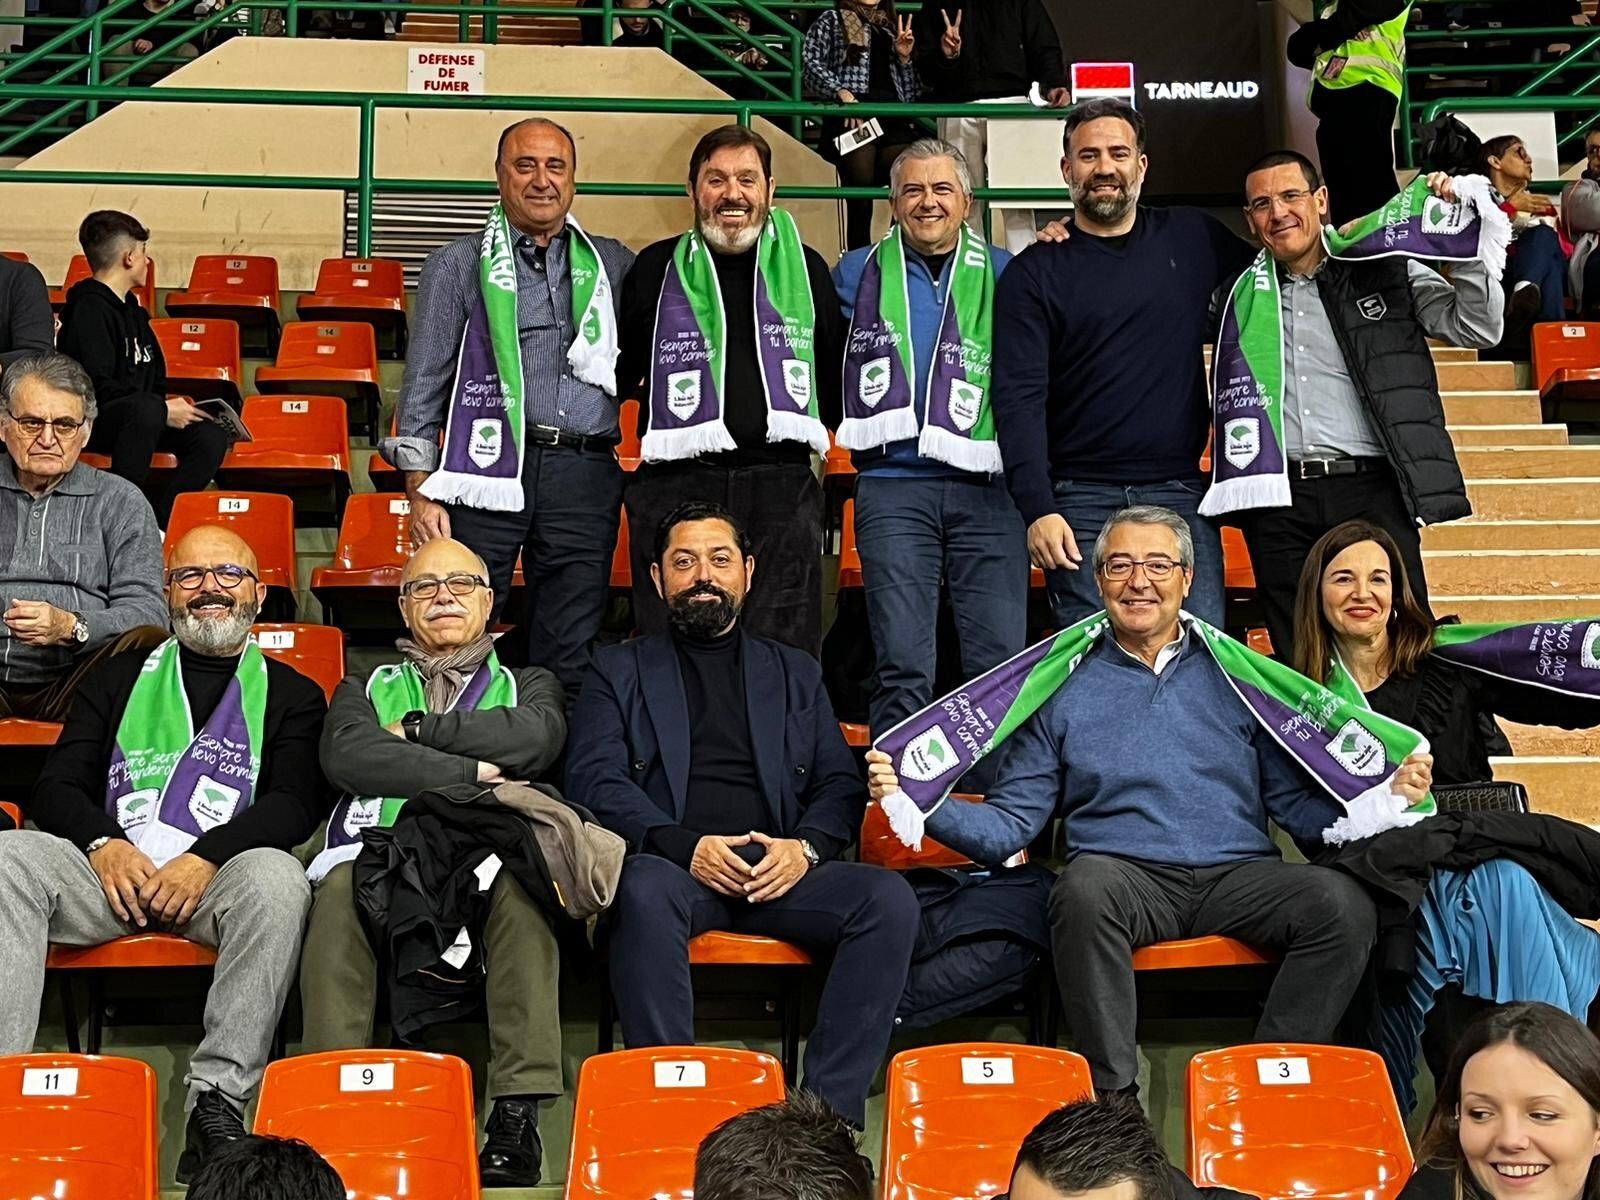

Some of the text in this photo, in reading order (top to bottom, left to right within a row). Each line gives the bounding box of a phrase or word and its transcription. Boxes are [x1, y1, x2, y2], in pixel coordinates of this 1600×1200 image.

[438, 67, 455, 78] DE
[424, 80, 469, 92] FUMER
[1143, 80, 1259, 100] TARNEAUD
[189, 324, 199, 332] 12
[289, 402, 302, 411] 14
[227, 500, 241, 510] 14
[272, 634, 282, 645] 11
[362, 1068, 374, 1085] 9
[674, 1065, 686, 1081] 7
[982, 1061, 994, 1078] 5
[1278, 1061, 1290, 1078] 3
[44, 1073, 60, 1090] 11
